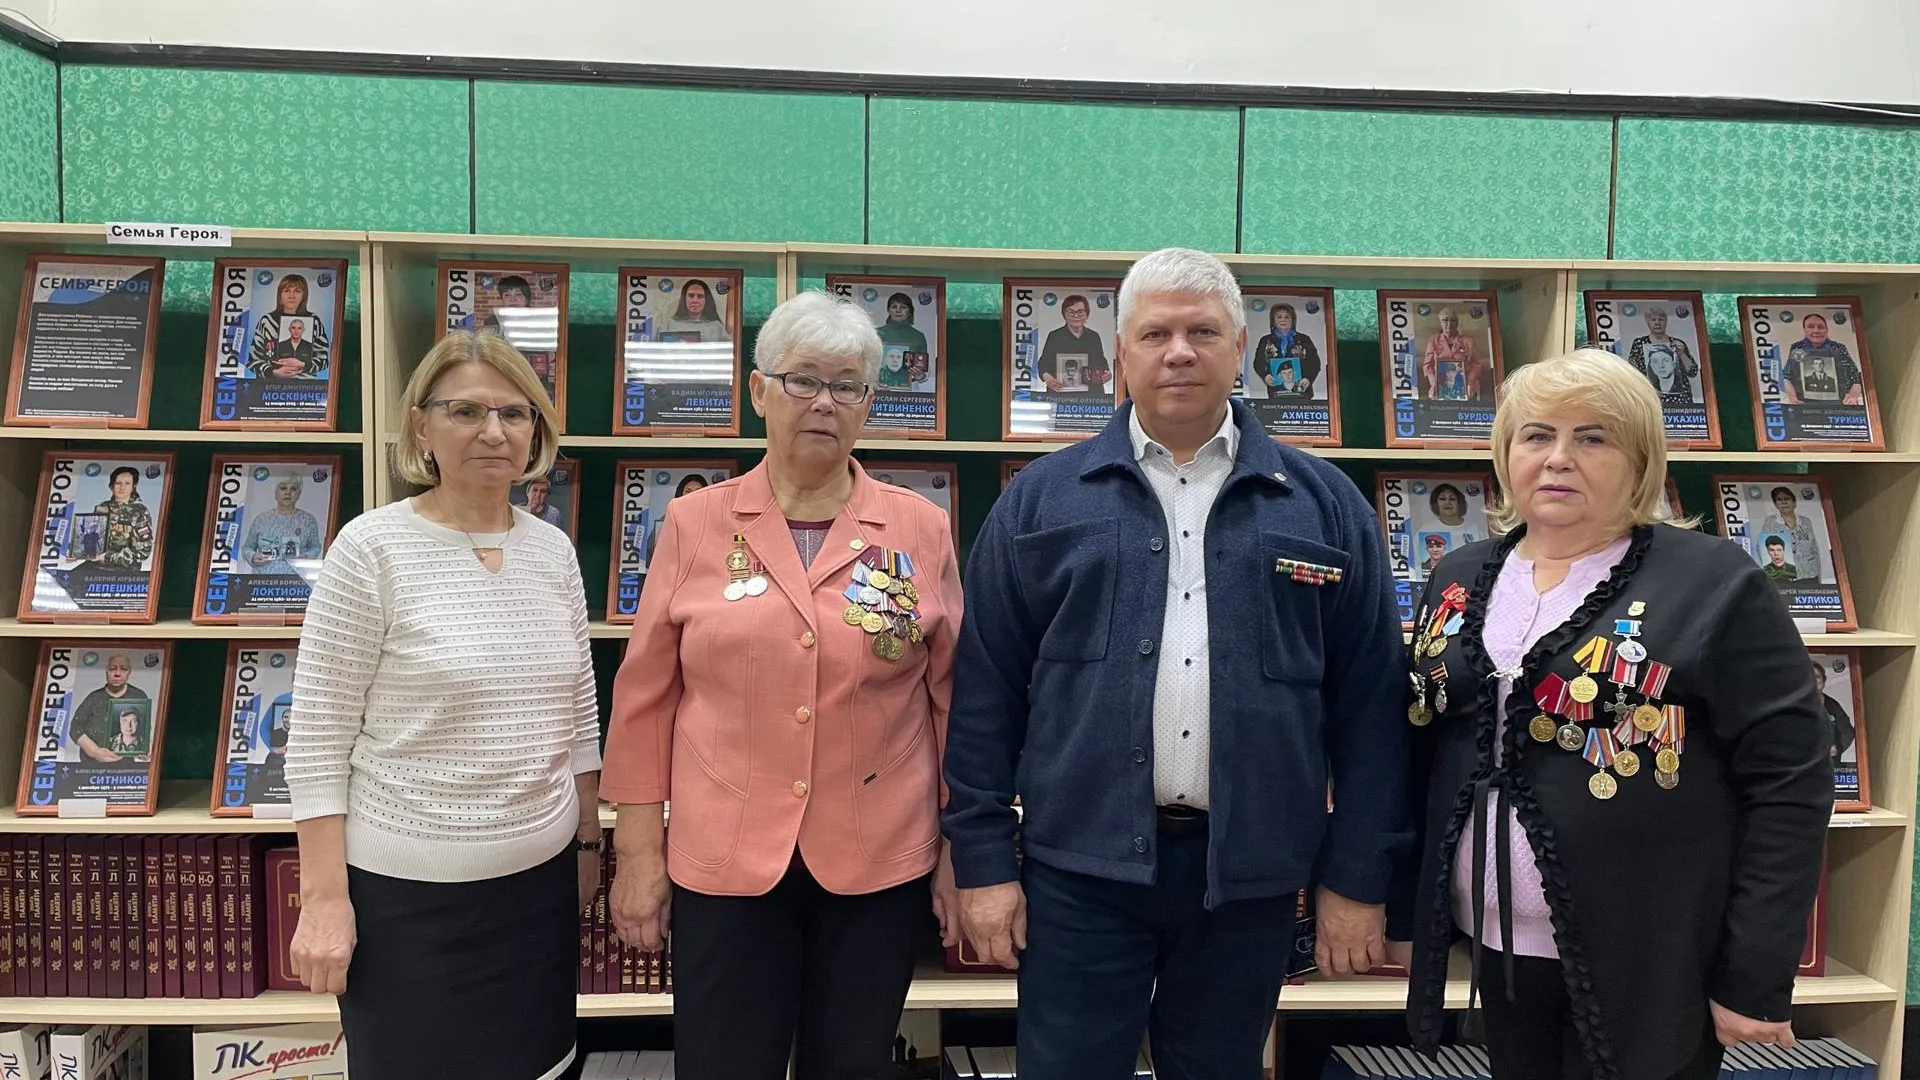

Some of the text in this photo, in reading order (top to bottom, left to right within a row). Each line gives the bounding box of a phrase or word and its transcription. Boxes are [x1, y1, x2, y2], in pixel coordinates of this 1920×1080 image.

[671, 389, 695, 397] ВАДИМ
[685, 398, 732, 407] ЛЕВИТАН
[1282, 411, 1329, 420] АХМЕТОВ
[1457, 411, 1495, 421] БУРДОВ
[1828, 415, 1867, 425] ТУРКИН
[88, 583, 149, 593] ЛЕПЕШКИН
[1795, 596, 1840, 604] КУЛИКОВ
[89, 775, 149, 785] СИТНИКОВ
[16, 869, 23, 879] К
[31, 870, 38, 879] К
[51, 873, 59, 882] К
[72, 873, 80, 882] К
[91, 872, 99, 881] Л
[109, 872, 117, 882] Л
[128, 872, 136, 882] Л
[165, 872, 176, 882] М
[225, 874, 231, 884] П
[241, 874, 249, 884] П
[148, 875, 158, 885] М
[211, 1040, 265, 1074] ПК
